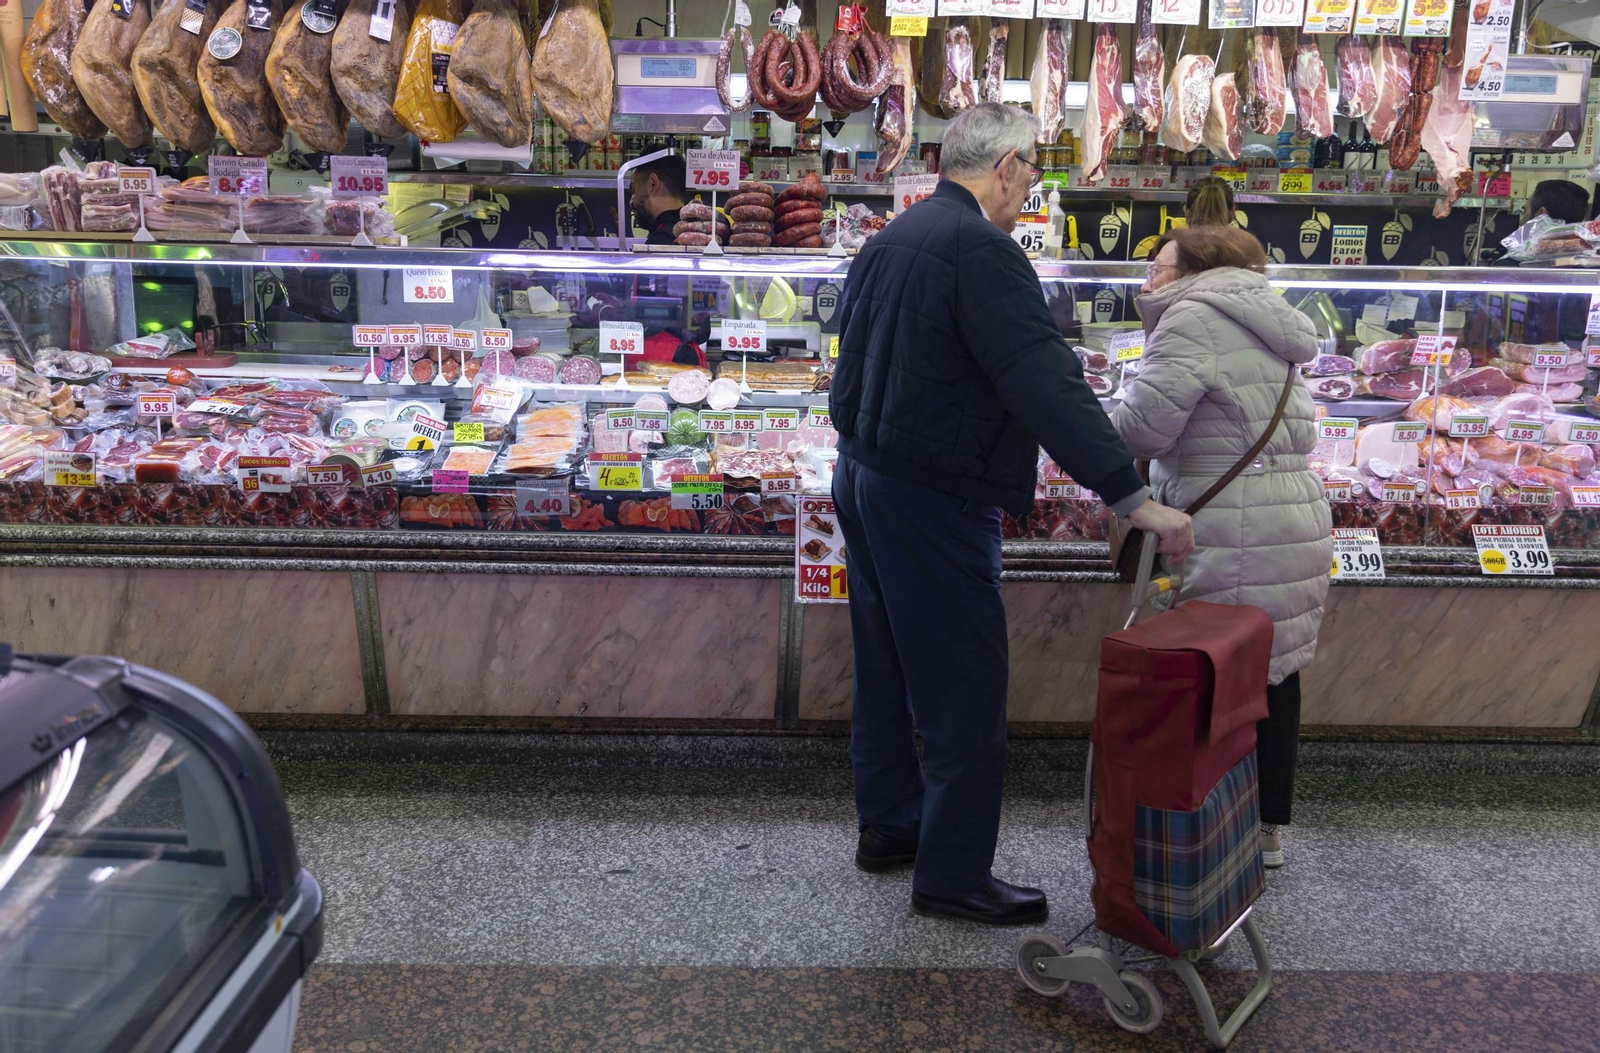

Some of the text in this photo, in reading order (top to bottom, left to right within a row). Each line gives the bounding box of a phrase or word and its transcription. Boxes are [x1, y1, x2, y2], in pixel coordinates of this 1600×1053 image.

[1486, 16, 1510, 25] 2.50
[1478, 82, 1501, 91] 4.50
[688, 150, 707, 159] Sarta
[708, 151, 716, 159] de
[213, 157, 264, 167] Jamón Curado
[214, 168, 240, 178] Bodega
[693, 170, 729, 186] 7.95
[125, 179, 148, 190] 6.95
[338, 176, 384, 192] 10.95
[1110, 178, 1130, 187] 3.25
[1418, 182, 1439, 193] 4.40
[1390, 184, 1409, 193] 2.95
[1101, 228, 1118, 238] EB
[1021, 234, 1043, 251] 95
[1301, 234, 1318, 243] EB
[1333, 238, 1364, 246] Lomos
[1383, 235, 1401, 244] EB
[1332, 247, 1363, 255] Faroe
[406, 269, 426, 277] Queso
[333, 286, 349, 296] EB
[414, 286, 446, 300] 8.50
[819, 297, 835, 307] EB
[1096, 302, 1112, 312] EB
[602, 322, 625, 331] Empanada
[724, 321, 756, 330] Empanada
[357, 333, 382, 343] 10.50
[393, 335, 416, 343] 9.95
[425, 334, 448, 343] 11.95
[455, 338, 471, 348] 0.50
[485, 337, 506, 346] 8.50
[728, 336, 761, 348] 9.95
[610, 338, 635, 351] 8.95
[1537, 355, 1562, 365] 9.50
[143, 403, 169, 412] 9.95
[613, 417, 633, 428] 8.50
[641, 419, 660, 429] 7.95
[705, 420, 725, 430] 7.95
[735, 420, 754, 430] 8.95
[770, 418, 789, 428] 7.95
[413, 423, 441, 441] OFERTA
[1325, 427, 1347, 437] 9.95
[1457, 424, 1484, 433] 13.95
[1398, 431, 1417, 441] 8.50
[1512, 430, 1533, 440] 8.95
[1576, 431, 1598, 441] 8.50
[261, 458, 290, 466] Ibéricos
[602, 453, 627, 461] OFERTÓN
[63, 473, 91, 485] 13.95
[311, 472, 337, 483] 7.50
[367, 470, 392, 484] 4.10
[600, 467, 611, 486] 4
[245, 479, 258, 489] 36
[518, 479, 567, 489] Salmón Ahumado
[767, 480, 790, 491] 8.95
[1050, 487, 1075, 496] 57 58
[1337, 491, 1346, 499] 42
[1386, 492, 1410, 500] 17 18
[691, 494, 722, 509] 5.50
[1449, 498, 1476, 507] 18 19
[1520, 494, 1532, 503] 9.95
[1578, 494, 1587, 503] 16
[525, 498, 562, 513] 4.40
[1334, 529, 1374, 538] AHORRO
[1475, 526, 1540, 535] LOTE AHORRO
[1341, 554, 1381, 572] 3.99
[1509, 550, 1549, 569] 3.99
[806, 567, 828, 580] 1/4
[833, 568, 847, 594] 1
[803, 582, 829, 593] Kilo
